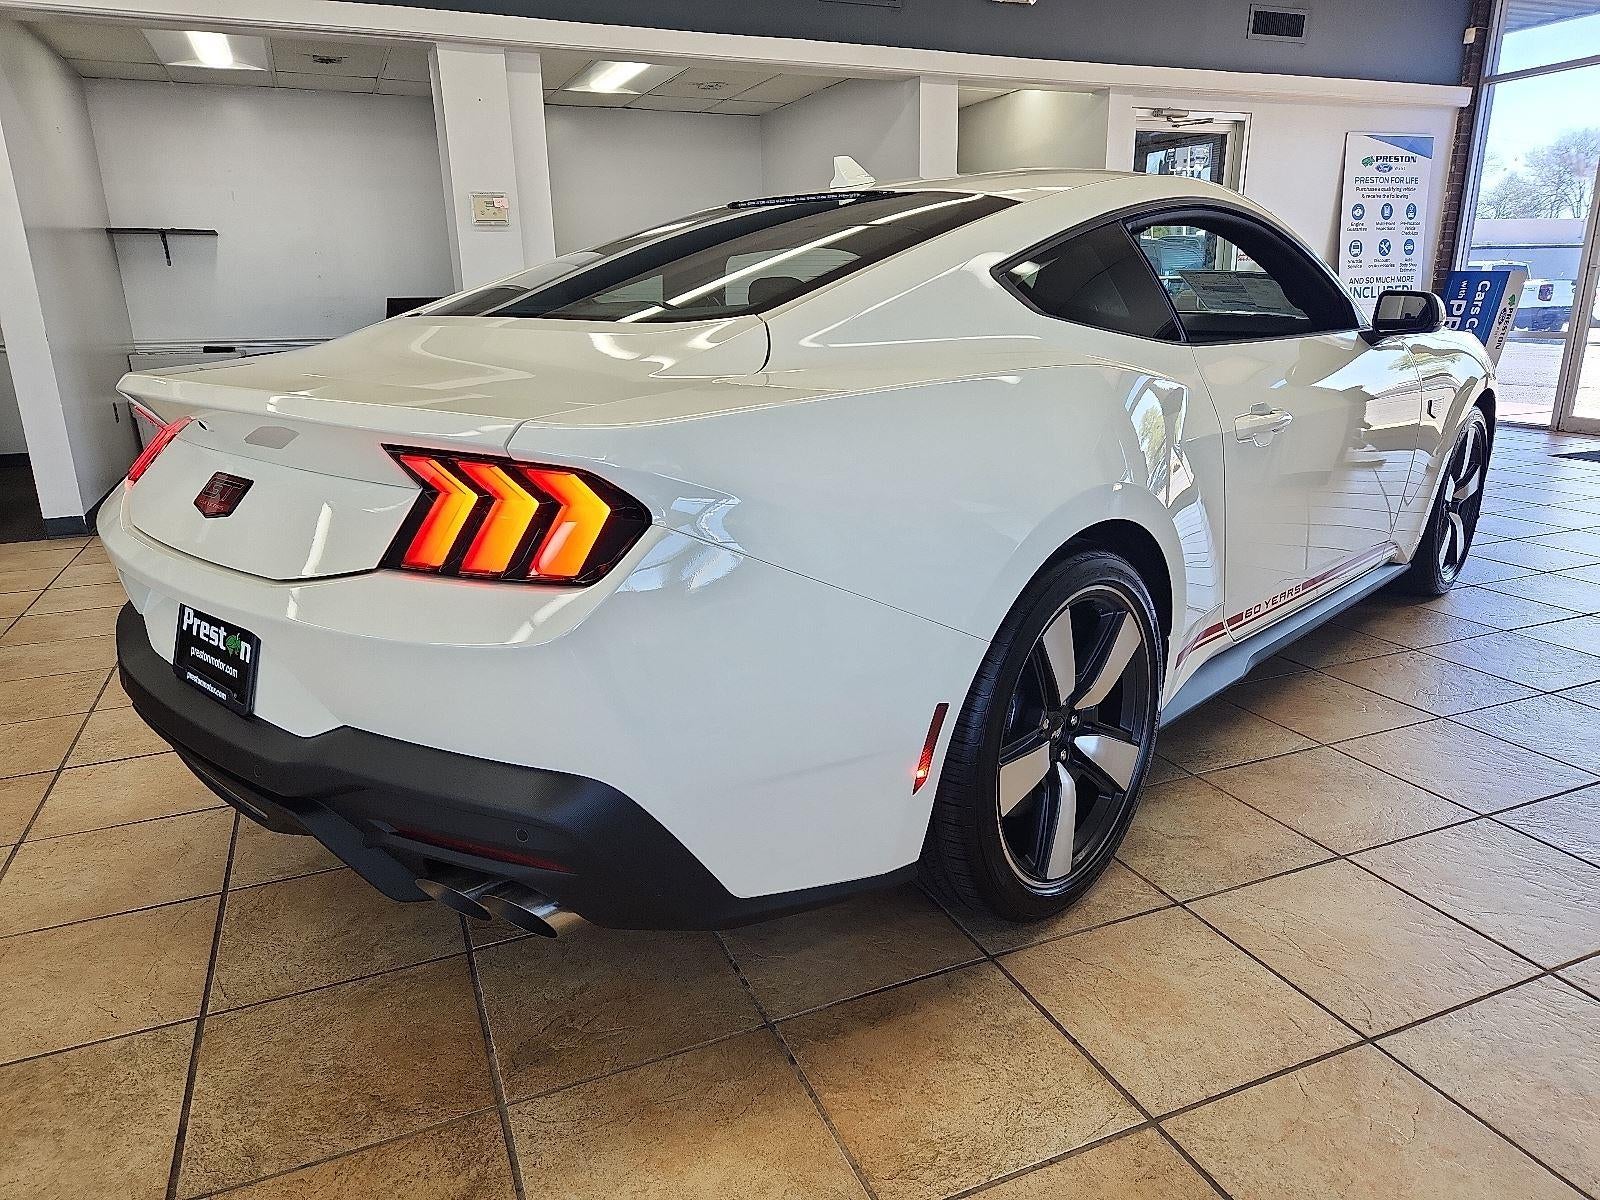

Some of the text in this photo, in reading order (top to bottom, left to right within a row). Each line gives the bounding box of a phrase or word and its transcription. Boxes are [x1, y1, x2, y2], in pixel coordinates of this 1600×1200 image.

[1375, 155, 1417, 163] PRESTON
[1354, 176, 1419, 185] PRESTON FOR LIFE
[1349, 275, 1415, 285] AND SO MUCH MORE
[1457, 280, 1468, 299] with
[1470, 280, 1491, 315] Cars
[1495, 307, 1515, 350] PRESTON
[1244, 583, 1302, 619] 60 YEARS
[190, 646, 239, 679] prestonmotor.com
